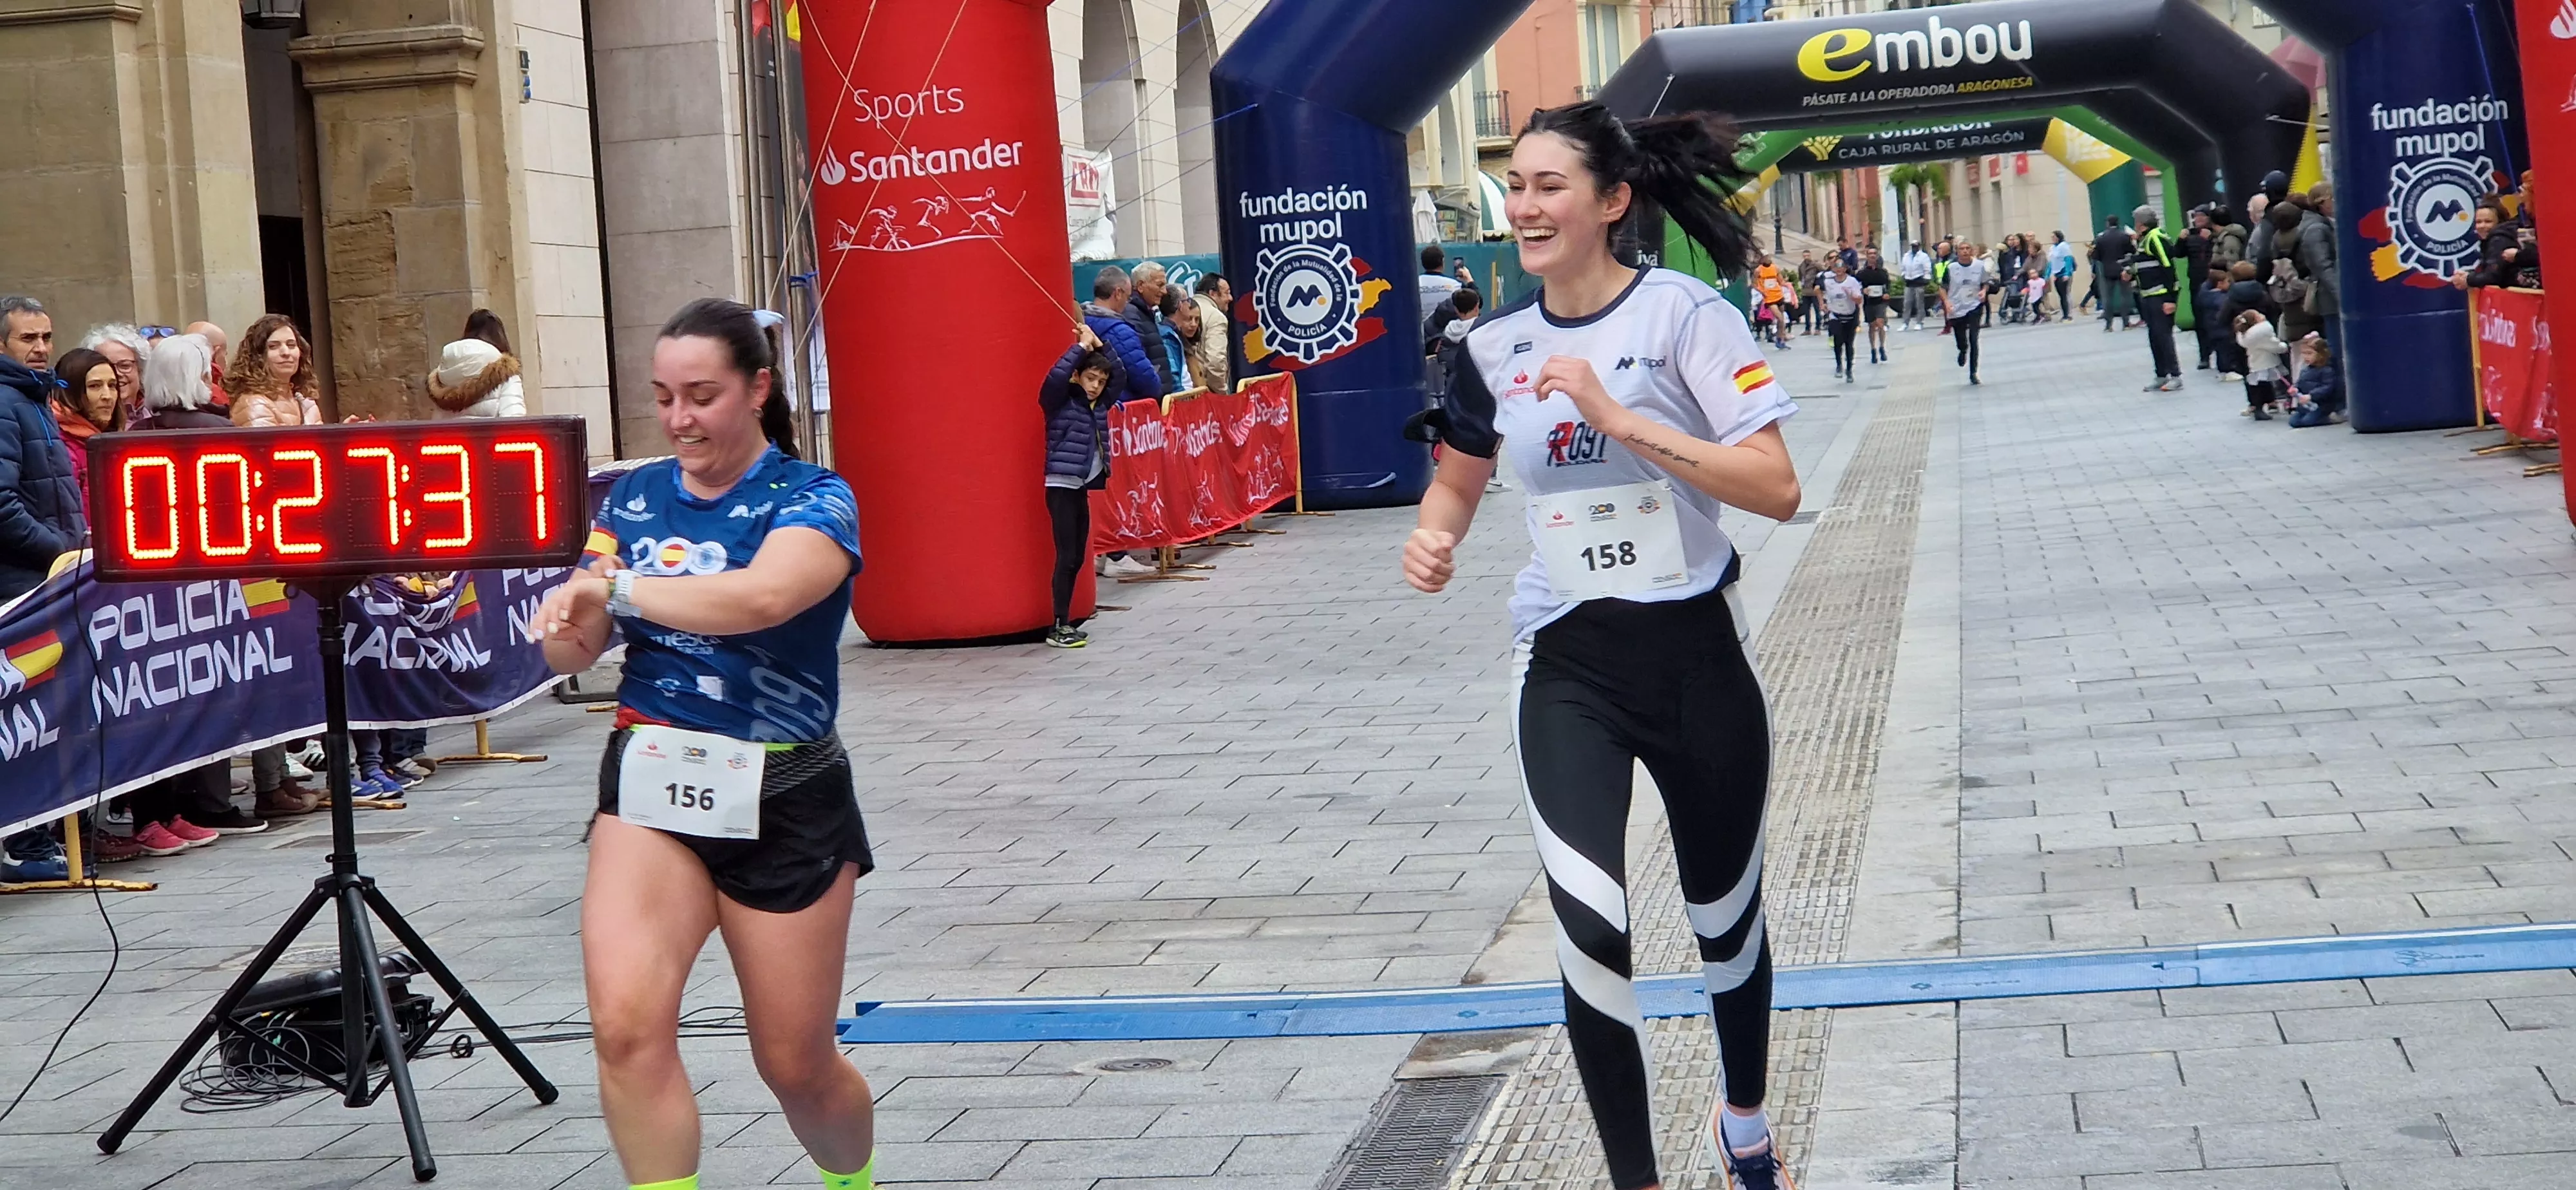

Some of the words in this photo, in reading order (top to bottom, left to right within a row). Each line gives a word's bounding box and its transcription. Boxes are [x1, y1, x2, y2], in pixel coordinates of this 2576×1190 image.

[1797, 15, 2033, 82] embou
[853, 84, 965, 129] Sports
[1803, 92, 1847, 107] PÁSATE
[1849, 92, 1858, 103] A
[1860, 91, 1875, 102] LA
[1878, 83, 1955, 100] OPERADORA
[1956, 76, 2033, 93] ARAGONESA
[2371, 94, 2508, 131] fundación
[1839, 146, 1878, 159] CAJA
[1881, 140, 1931, 155] RURAL
[1935, 138, 1955, 151] DE
[1960, 129, 2025, 147] ARAGÓN
[2395, 124, 2485, 158] mupol
[850, 138, 1023, 183] Santander
[1239, 183, 1368, 218] fundación
[1260, 211, 1342, 245] mupol
[2425, 239, 2469, 254] POLICÍA
[1288, 323, 1327, 337] POLICÍA
[124, 442, 548, 560] 00:27:37
[1580, 541, 1636, 571] 158
[89, 579, 251, 661] POLICÍA
[91, 627, 292, 724] NACIONAL
[664, 782, 715, 811] 156
